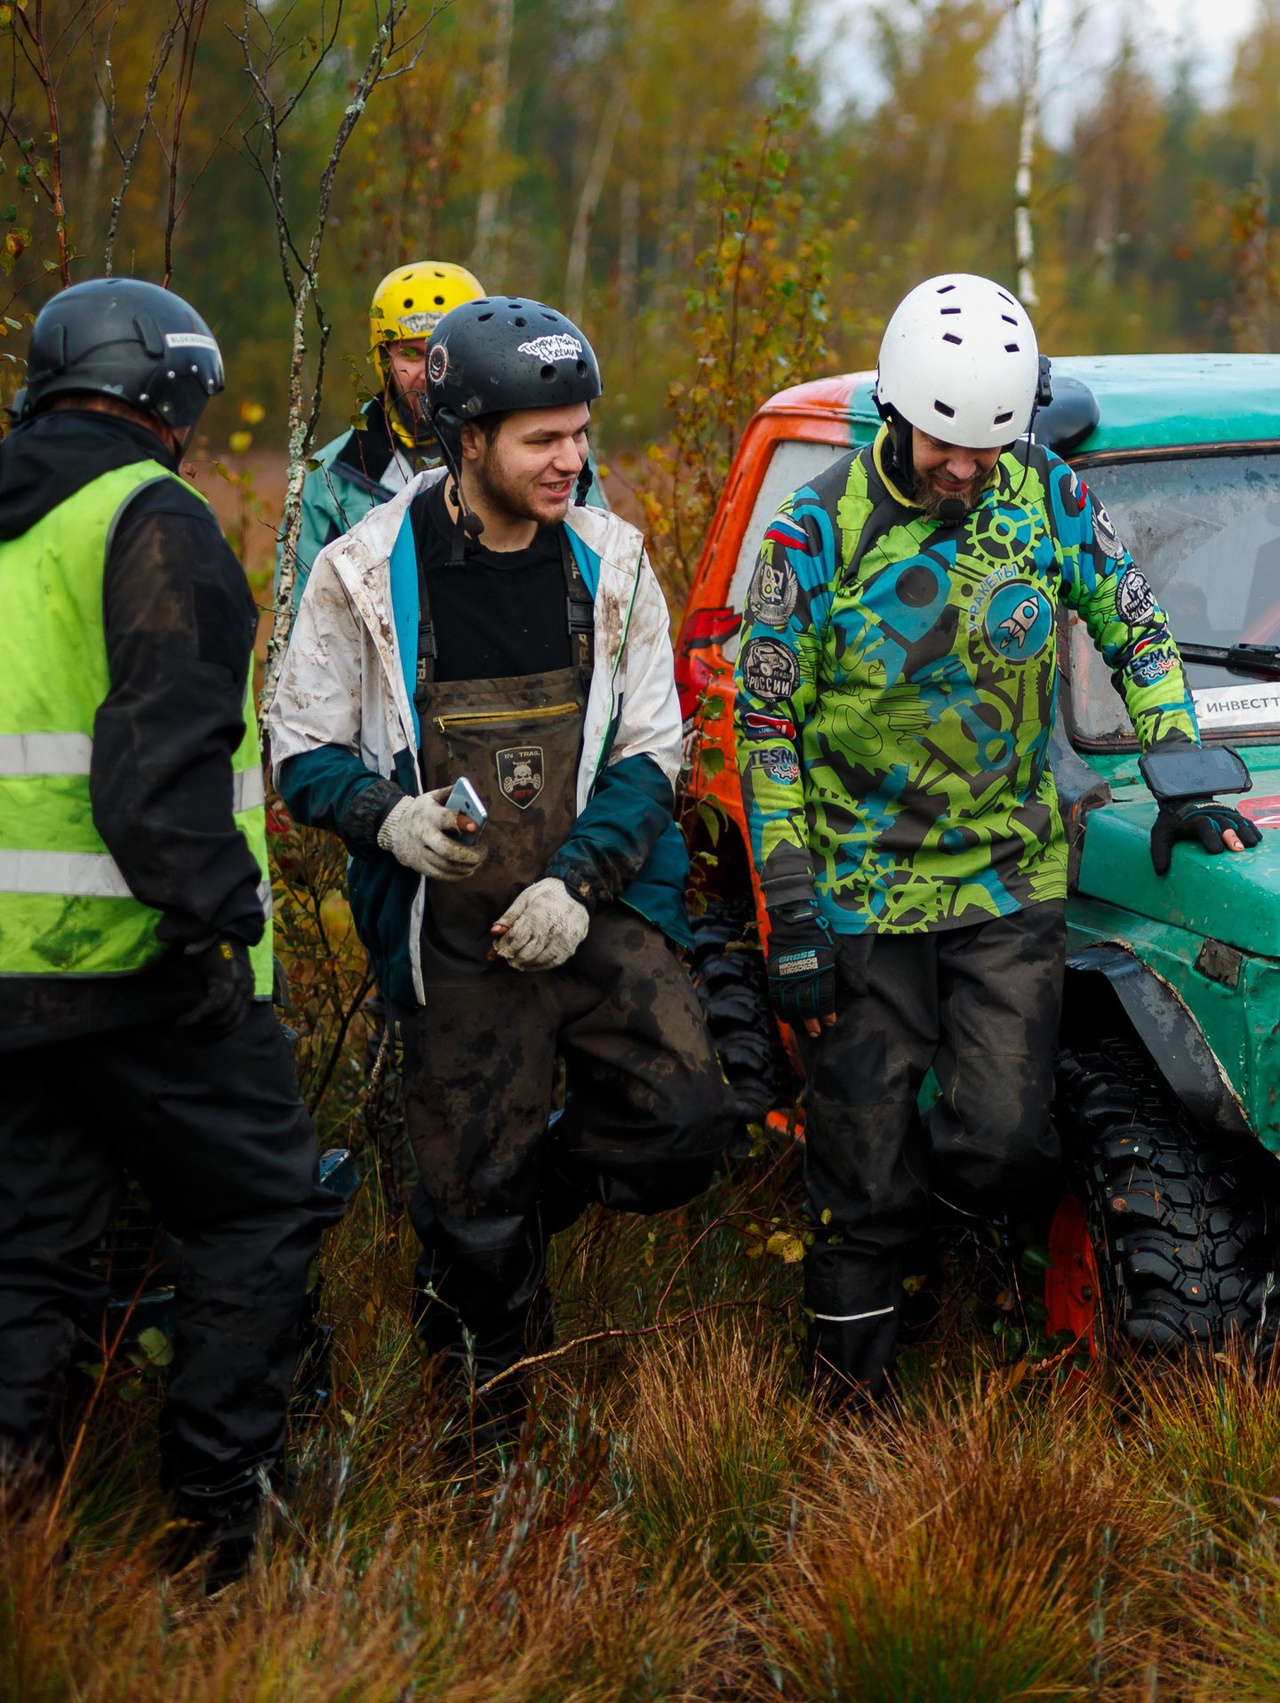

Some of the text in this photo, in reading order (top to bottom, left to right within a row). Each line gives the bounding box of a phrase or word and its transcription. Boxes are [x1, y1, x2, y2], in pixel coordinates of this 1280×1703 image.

[969, 564, 1019, 617] РАКЕТЫ
[1123, 646, 1178, 678] TESMA
[748, 676, 790, 695] РОССИИ
[519, 750, 541, 758] TRAIL
[779, 950, 816, 963] GROSS
